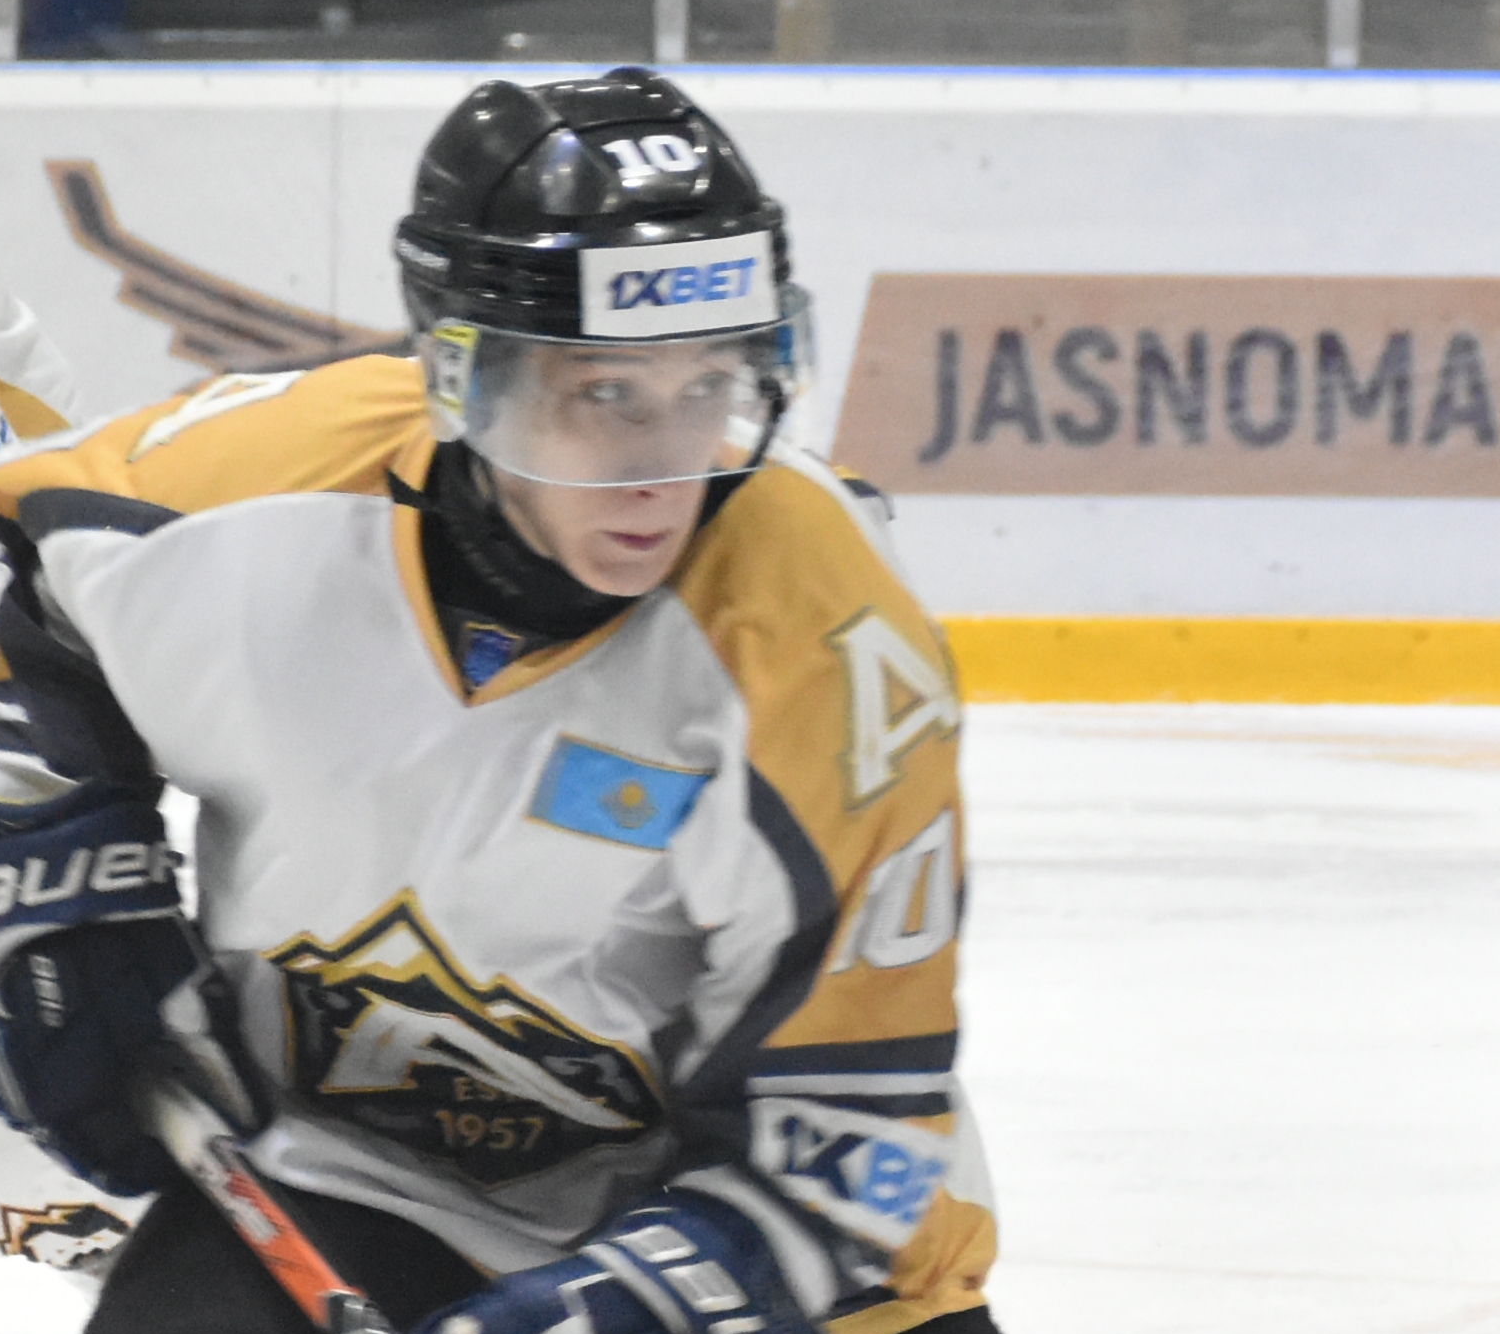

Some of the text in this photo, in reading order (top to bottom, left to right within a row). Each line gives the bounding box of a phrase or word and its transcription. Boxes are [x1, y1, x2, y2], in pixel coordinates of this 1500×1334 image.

[602, 134, 702, 180] 10
[609, 257, 757, 310] 1XBET
[826, 605, 960, 809] A
[435, 1110, 544, 1151] 1957
